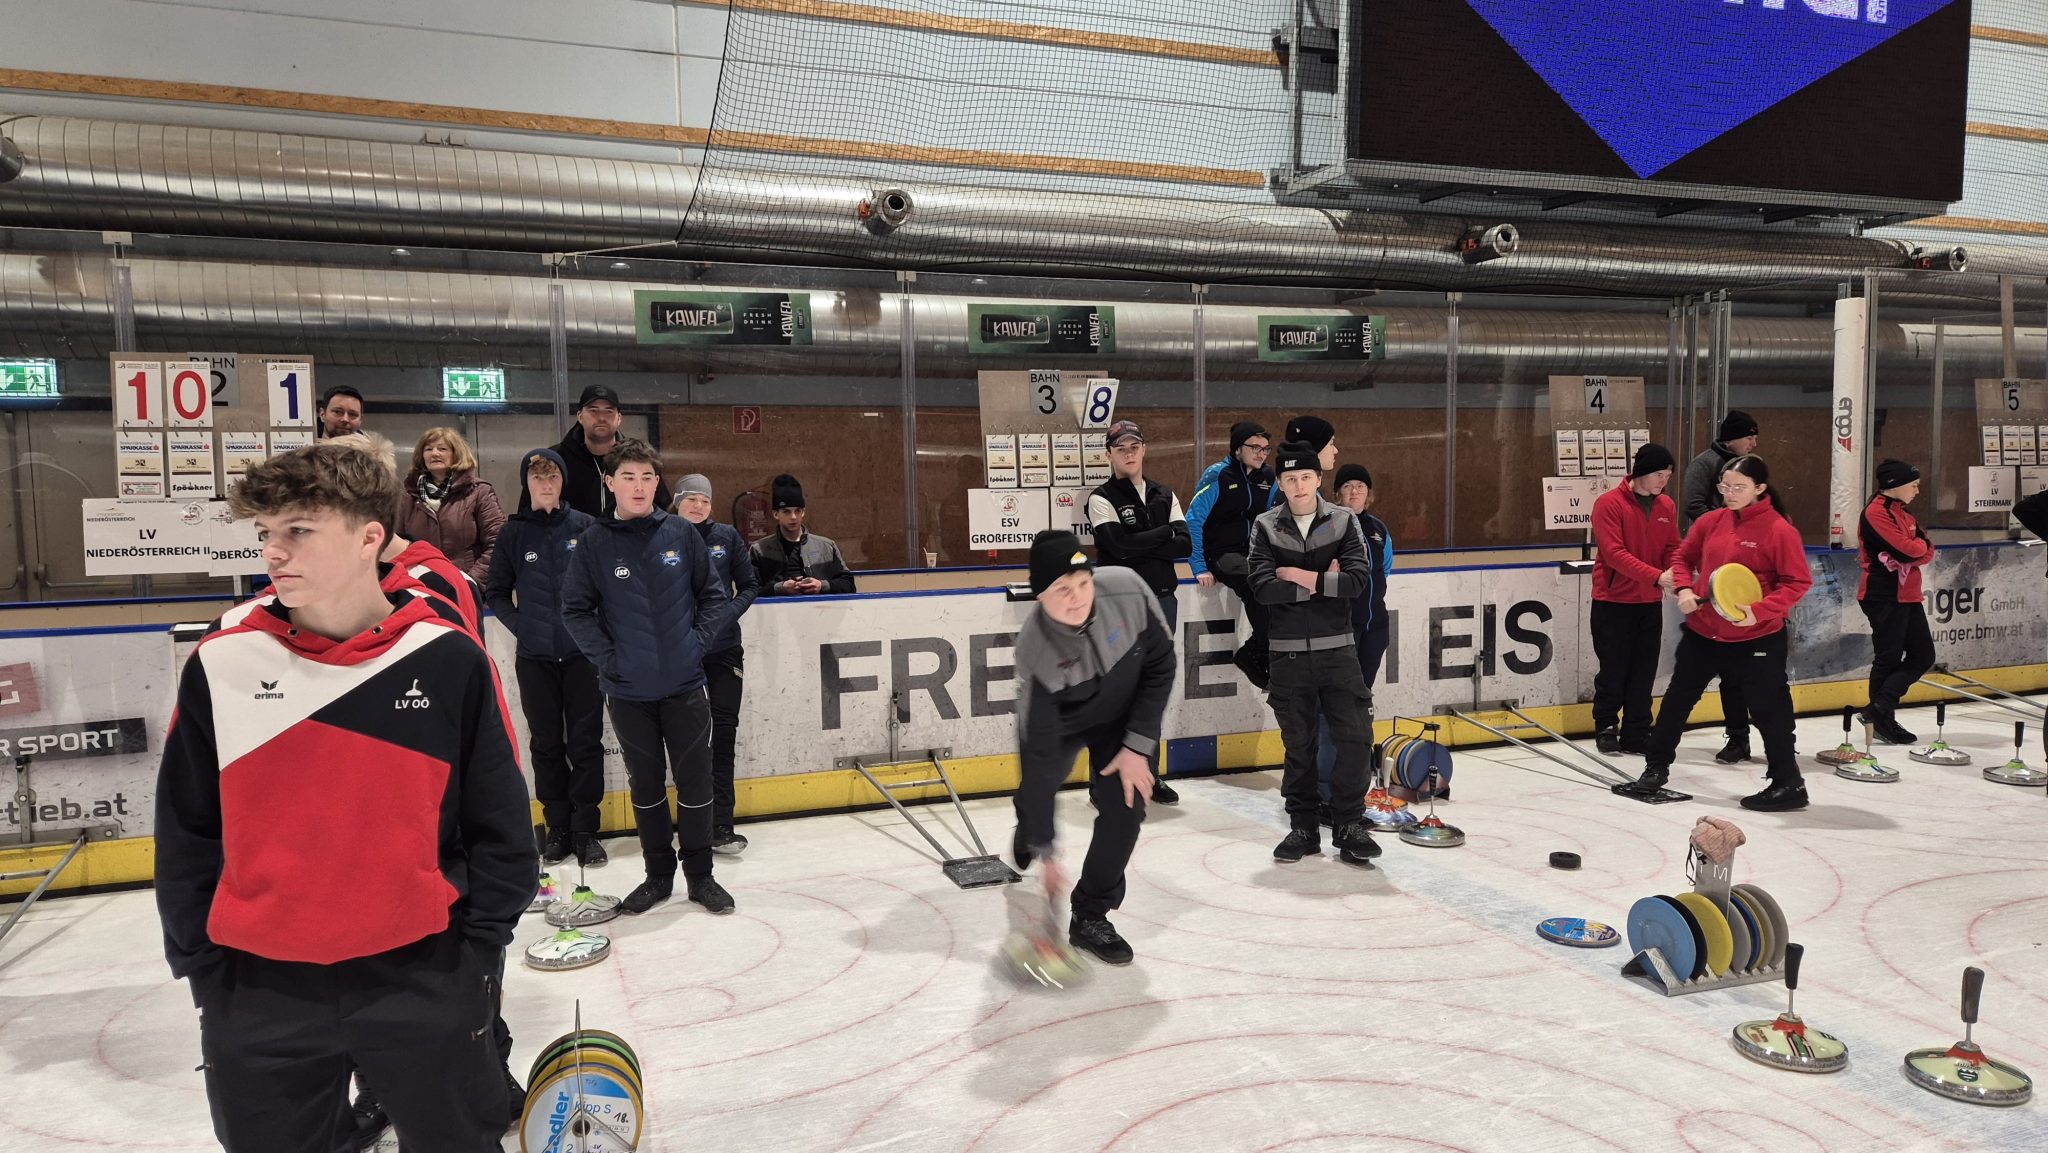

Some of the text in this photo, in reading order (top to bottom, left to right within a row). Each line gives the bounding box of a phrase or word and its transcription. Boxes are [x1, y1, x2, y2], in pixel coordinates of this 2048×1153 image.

[665, 309, 718, 327] KAWEA
[780, 301, 794, 338] KAWEA
[993, 321, 1036, 337] KAWEA
[1089, 313, 1100, 346] KAWEA
[1280, 331, 1317, 346] KAWEA
[1362, 322, 1372, 353] KAWEA
[1031, 373, 1060, 383] BAHN
[1585, 379, 1607, 387] BAHN
[279, 372, 299, 420] 1
[1038, 384, 1057, 415] 3
[1590, 388, 1605, 414] 4
[2008, 389, 2019, 411] 5
[1089, 386, 1112, 423] 8
[1991, 487, 1999, 495] LV
[2040, 483, 2047, 491] LV
[1569, 498, 1580, 507] LV
[1974, 499, 2012, 508] STEIERMARK
[1001, 517, 1020, 528] ESV
[1553, 514, 1591, 524] SALZBUR
[139, 529, 157, 540] LV
[1071, 522, 1093, 536] TIR
[971, 533, 1037, 544] GROßFEISTRI
[86, 546, 199, 558] NIEDERÖSTERREICH
[211, 547, 264, 560] OBERÖST
[1923, 587, 2025, 624] nger GmbH
[1429, 600, 1554, 681] EIS
[254, 691, 284, 700] erima
[395, 697, 430, 709] LV OÖ
[17, 728, 119, 756] SPORT
[603, 1104, 612, 1114] S
[545, 1092, 570, 1153] adler
